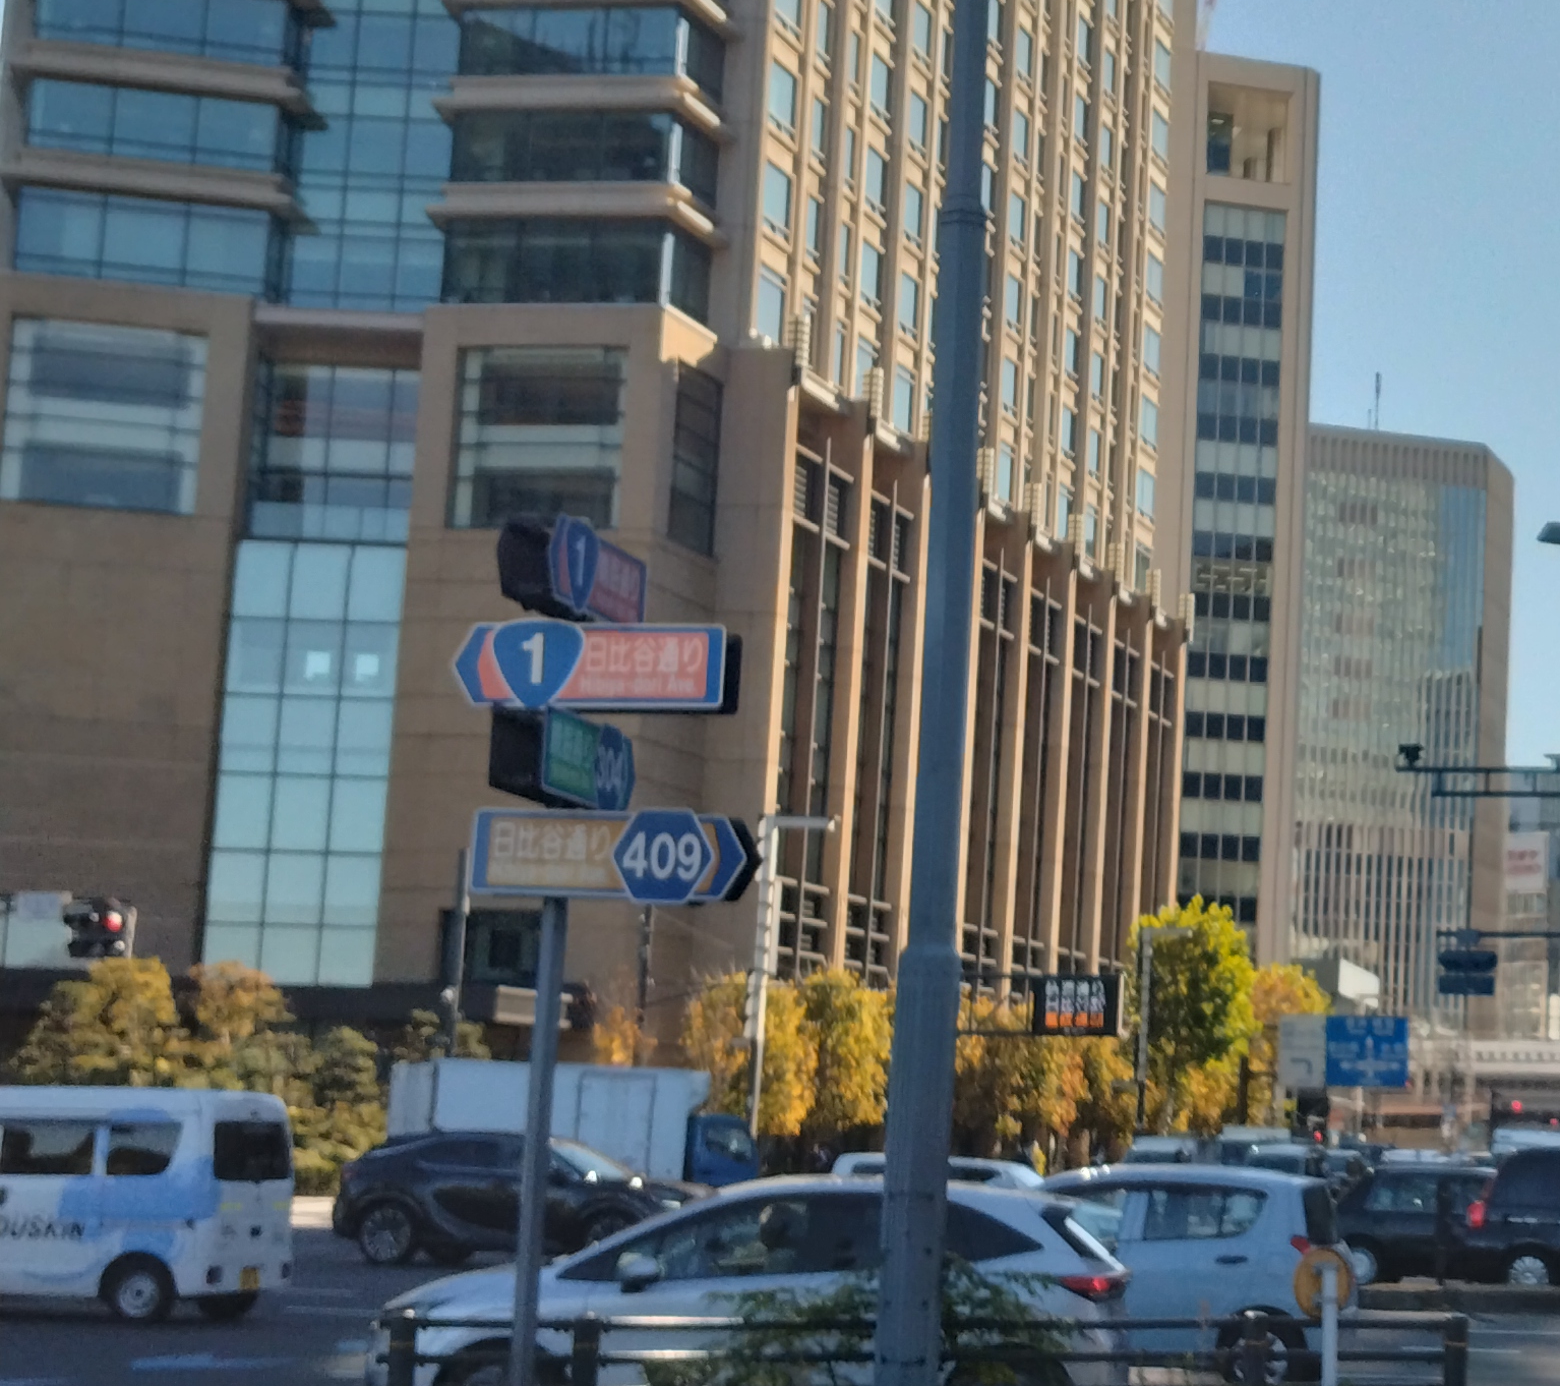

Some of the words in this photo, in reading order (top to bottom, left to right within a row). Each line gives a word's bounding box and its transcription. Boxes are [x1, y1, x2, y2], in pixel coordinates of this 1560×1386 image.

[573, 534, 586, 587] 1
[521, 631, 545, 685] 1
[585, 636, 703, 674] 日比谷通り
[494, 821, 611, 861] 日比谷通り
[622, 830, 702, 881] 409
